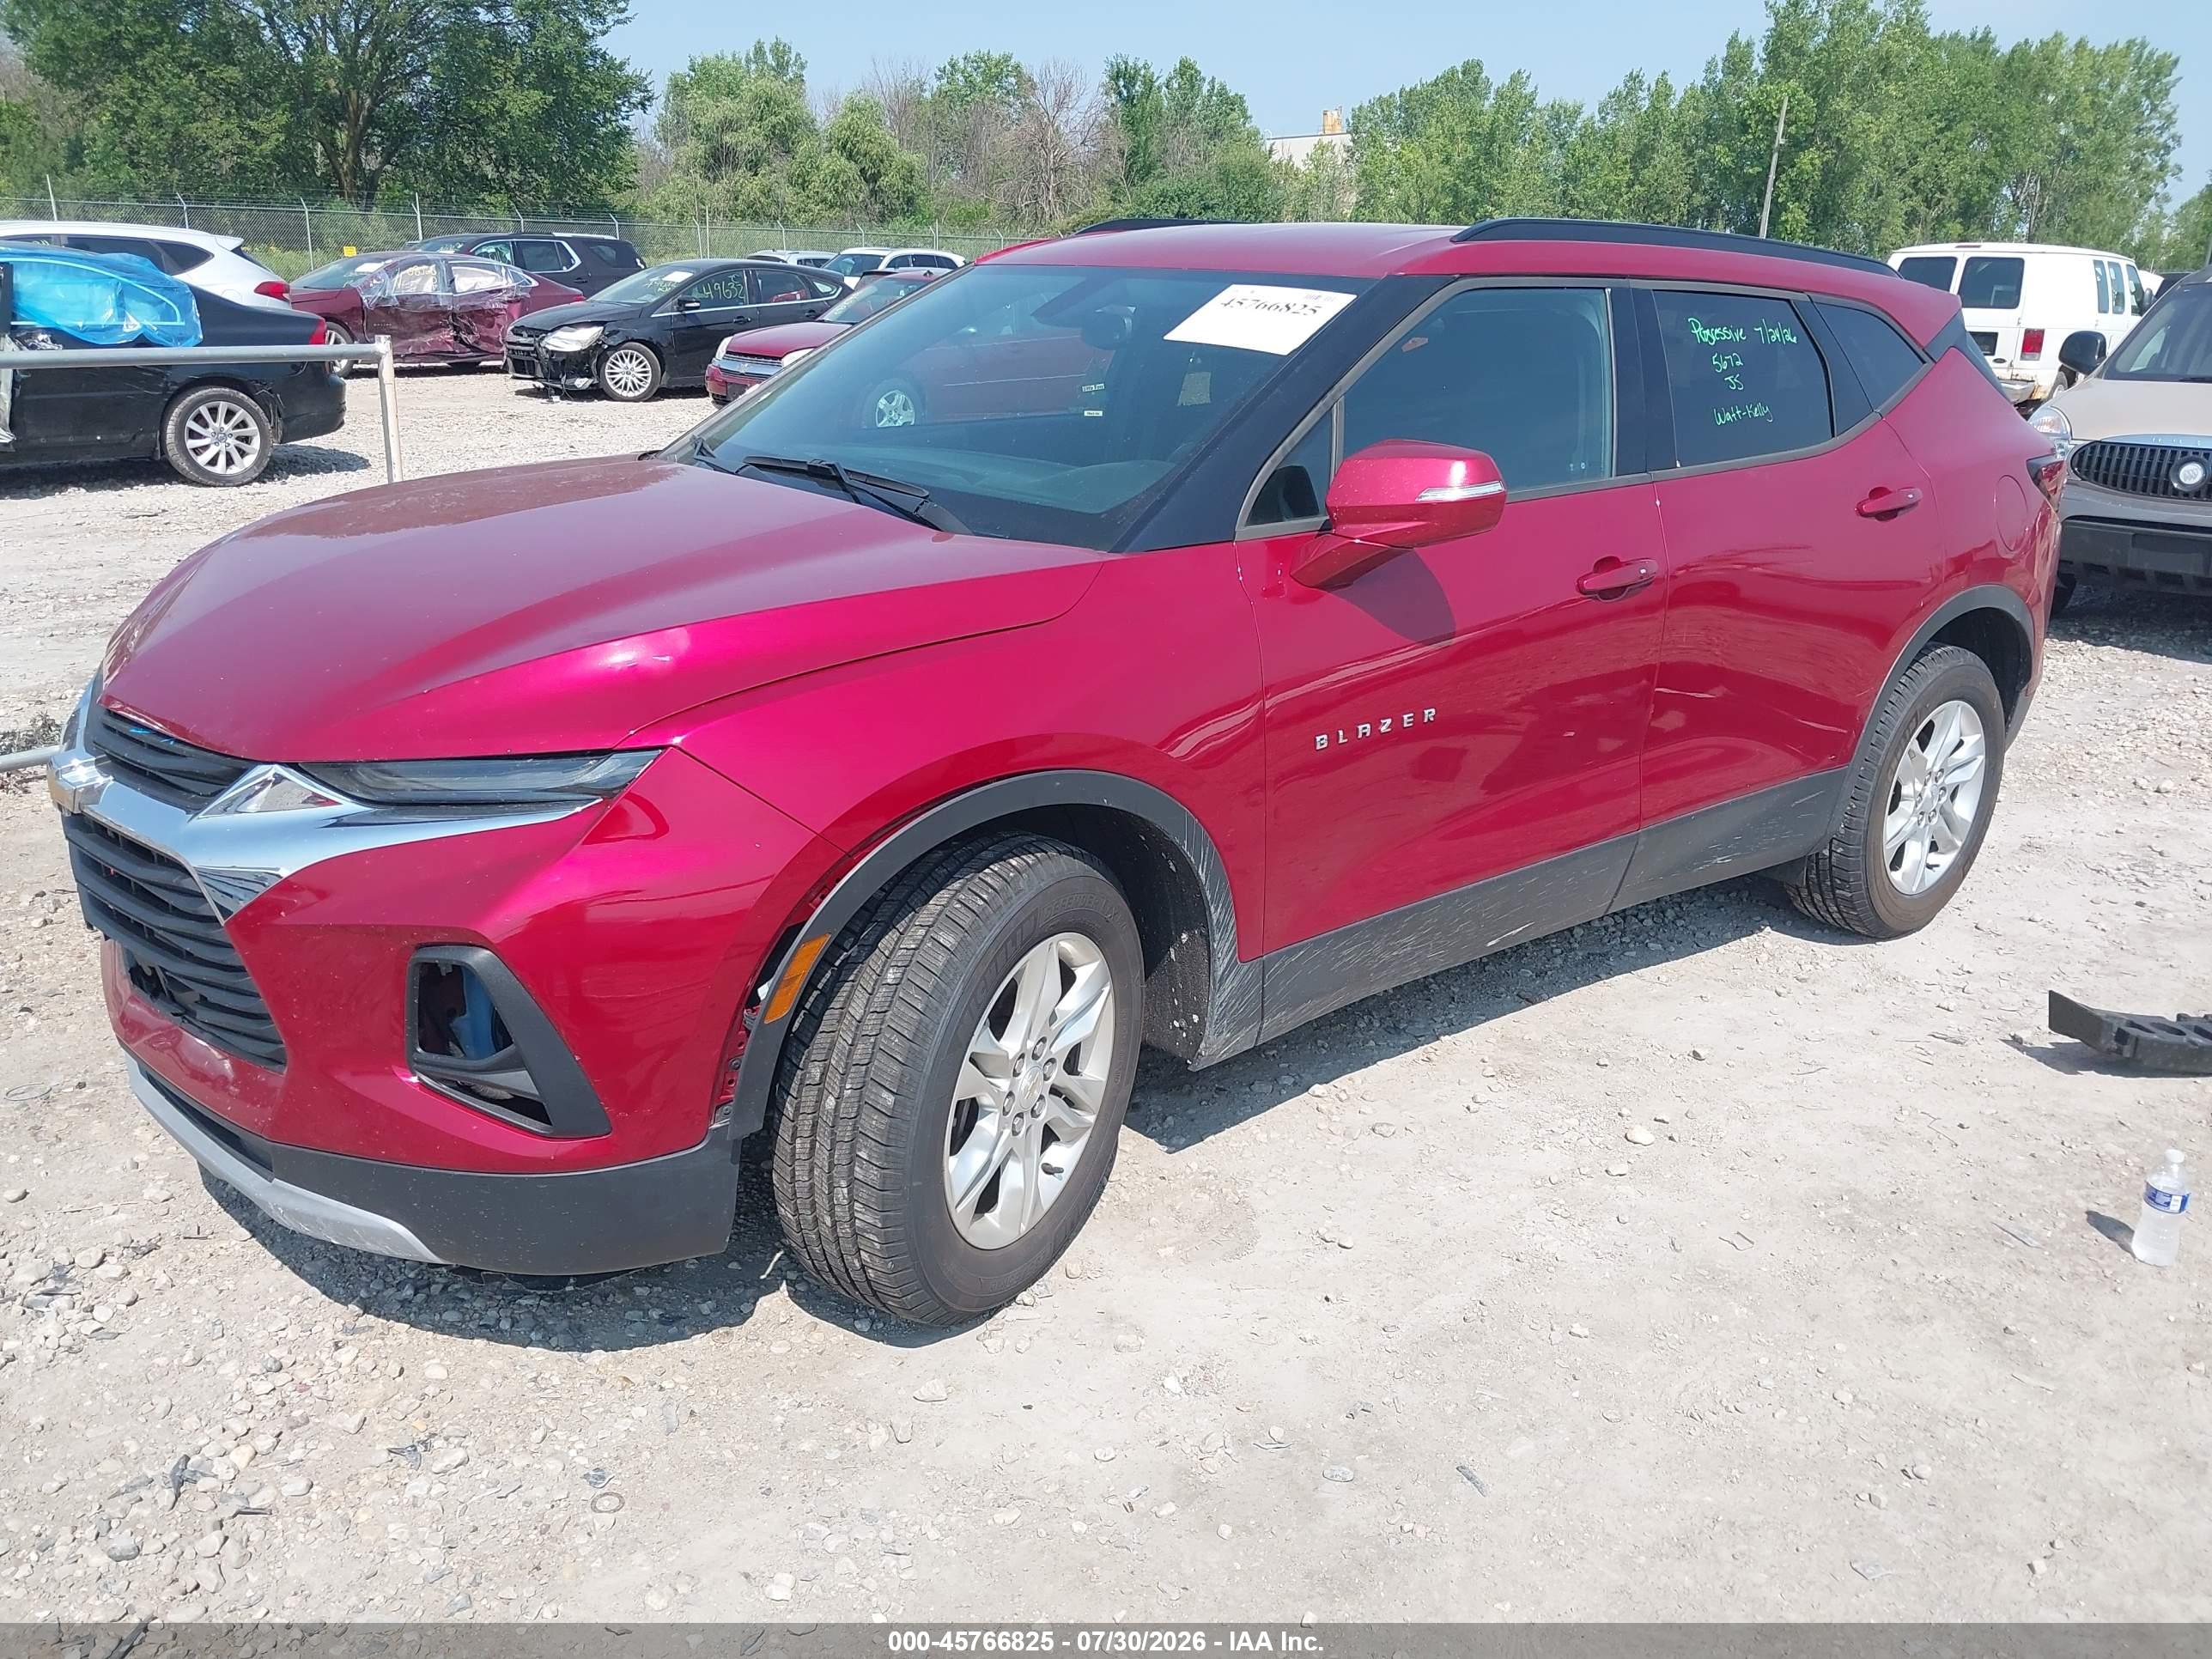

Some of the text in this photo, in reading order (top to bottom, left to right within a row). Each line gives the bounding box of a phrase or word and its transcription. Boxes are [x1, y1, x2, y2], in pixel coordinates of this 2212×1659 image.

[1219, 297, 1323, 316] 45766825
[1753, 318, 1797, 346] 7/24/26
[1711, 352, 1744, 373] 5672
[1724, 374, 1744, 391] JS
[1713, 402, 1773, 426] Watt-Kelly
[1315, 708, 1437, 750] BLAZER
